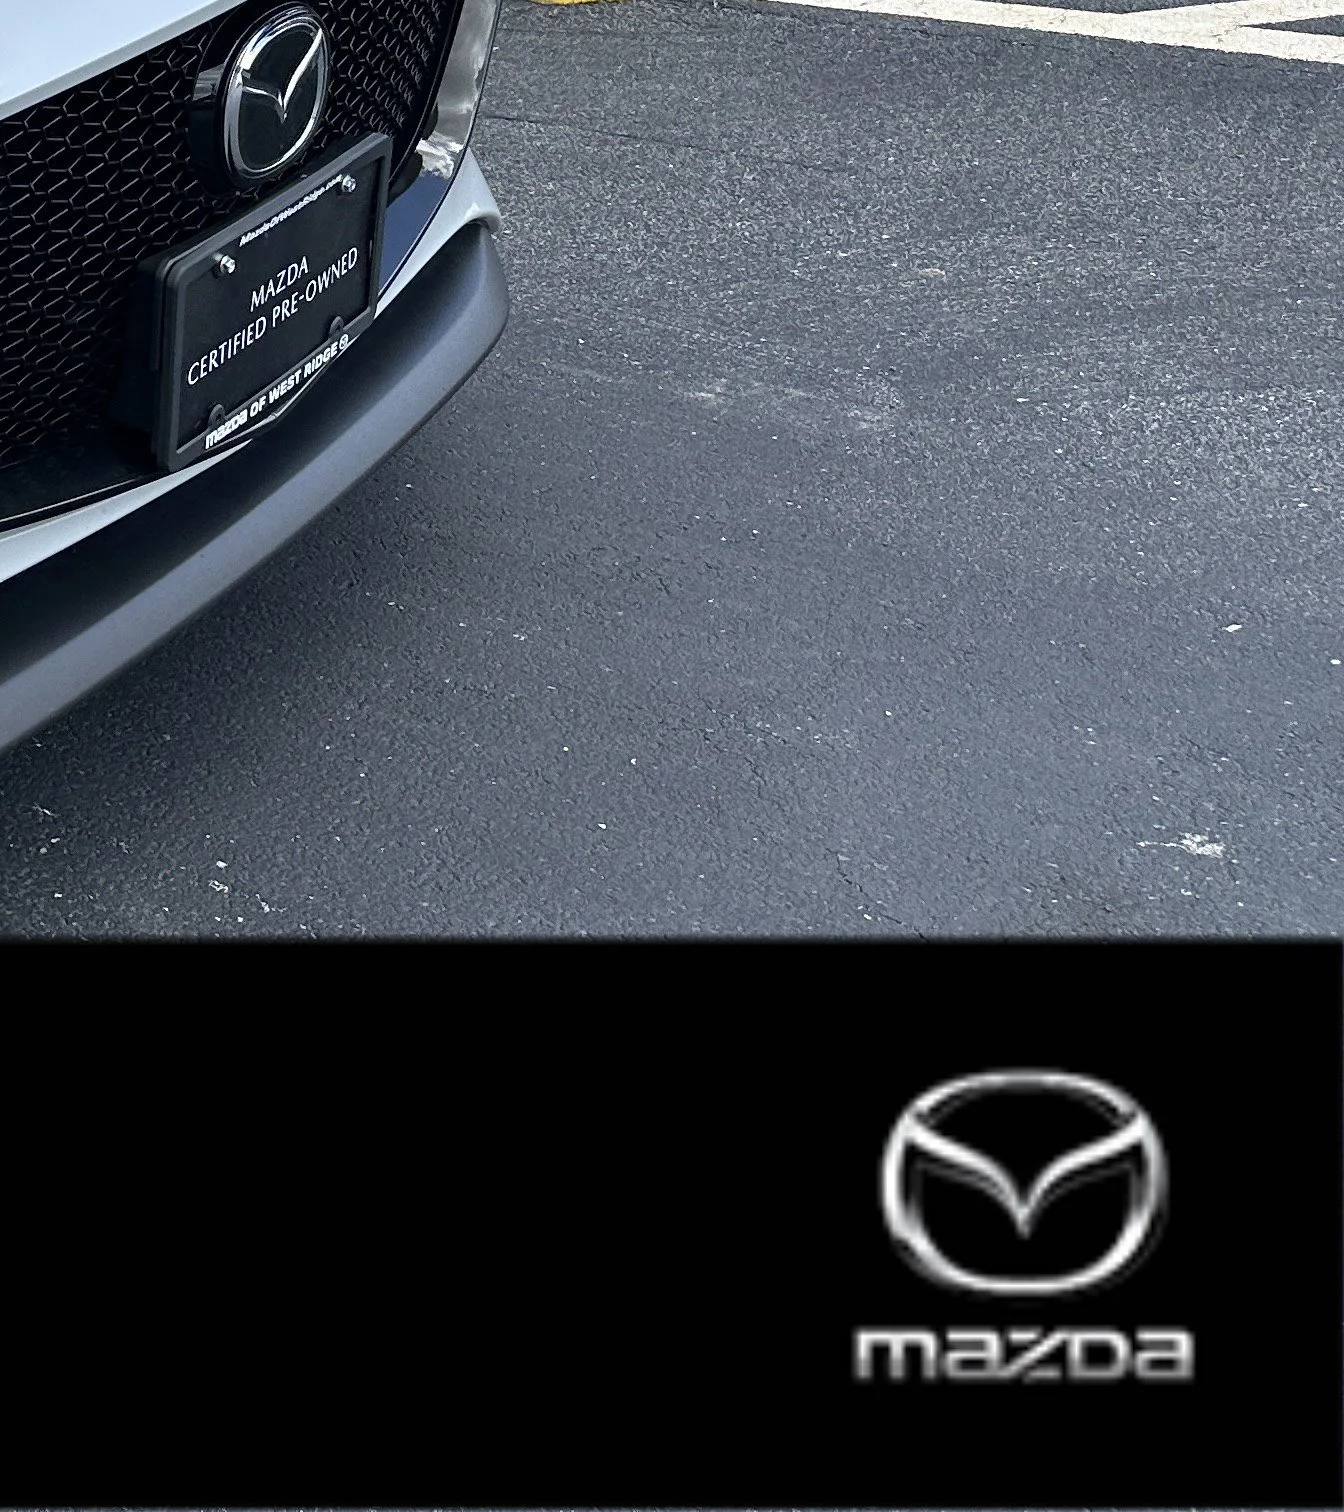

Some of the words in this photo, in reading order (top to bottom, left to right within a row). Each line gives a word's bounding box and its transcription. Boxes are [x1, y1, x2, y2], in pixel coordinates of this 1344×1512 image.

[187, 316, 267, 385] CERTIFIED
[272, 247, 358, 328] PRE-OWNED
[250, 256, 308, 312] MAZDA
[249, 395, 266, 418] OF
[268, 369, 302, 405] WEST
[303, 339, 338, 378] RIDGE
